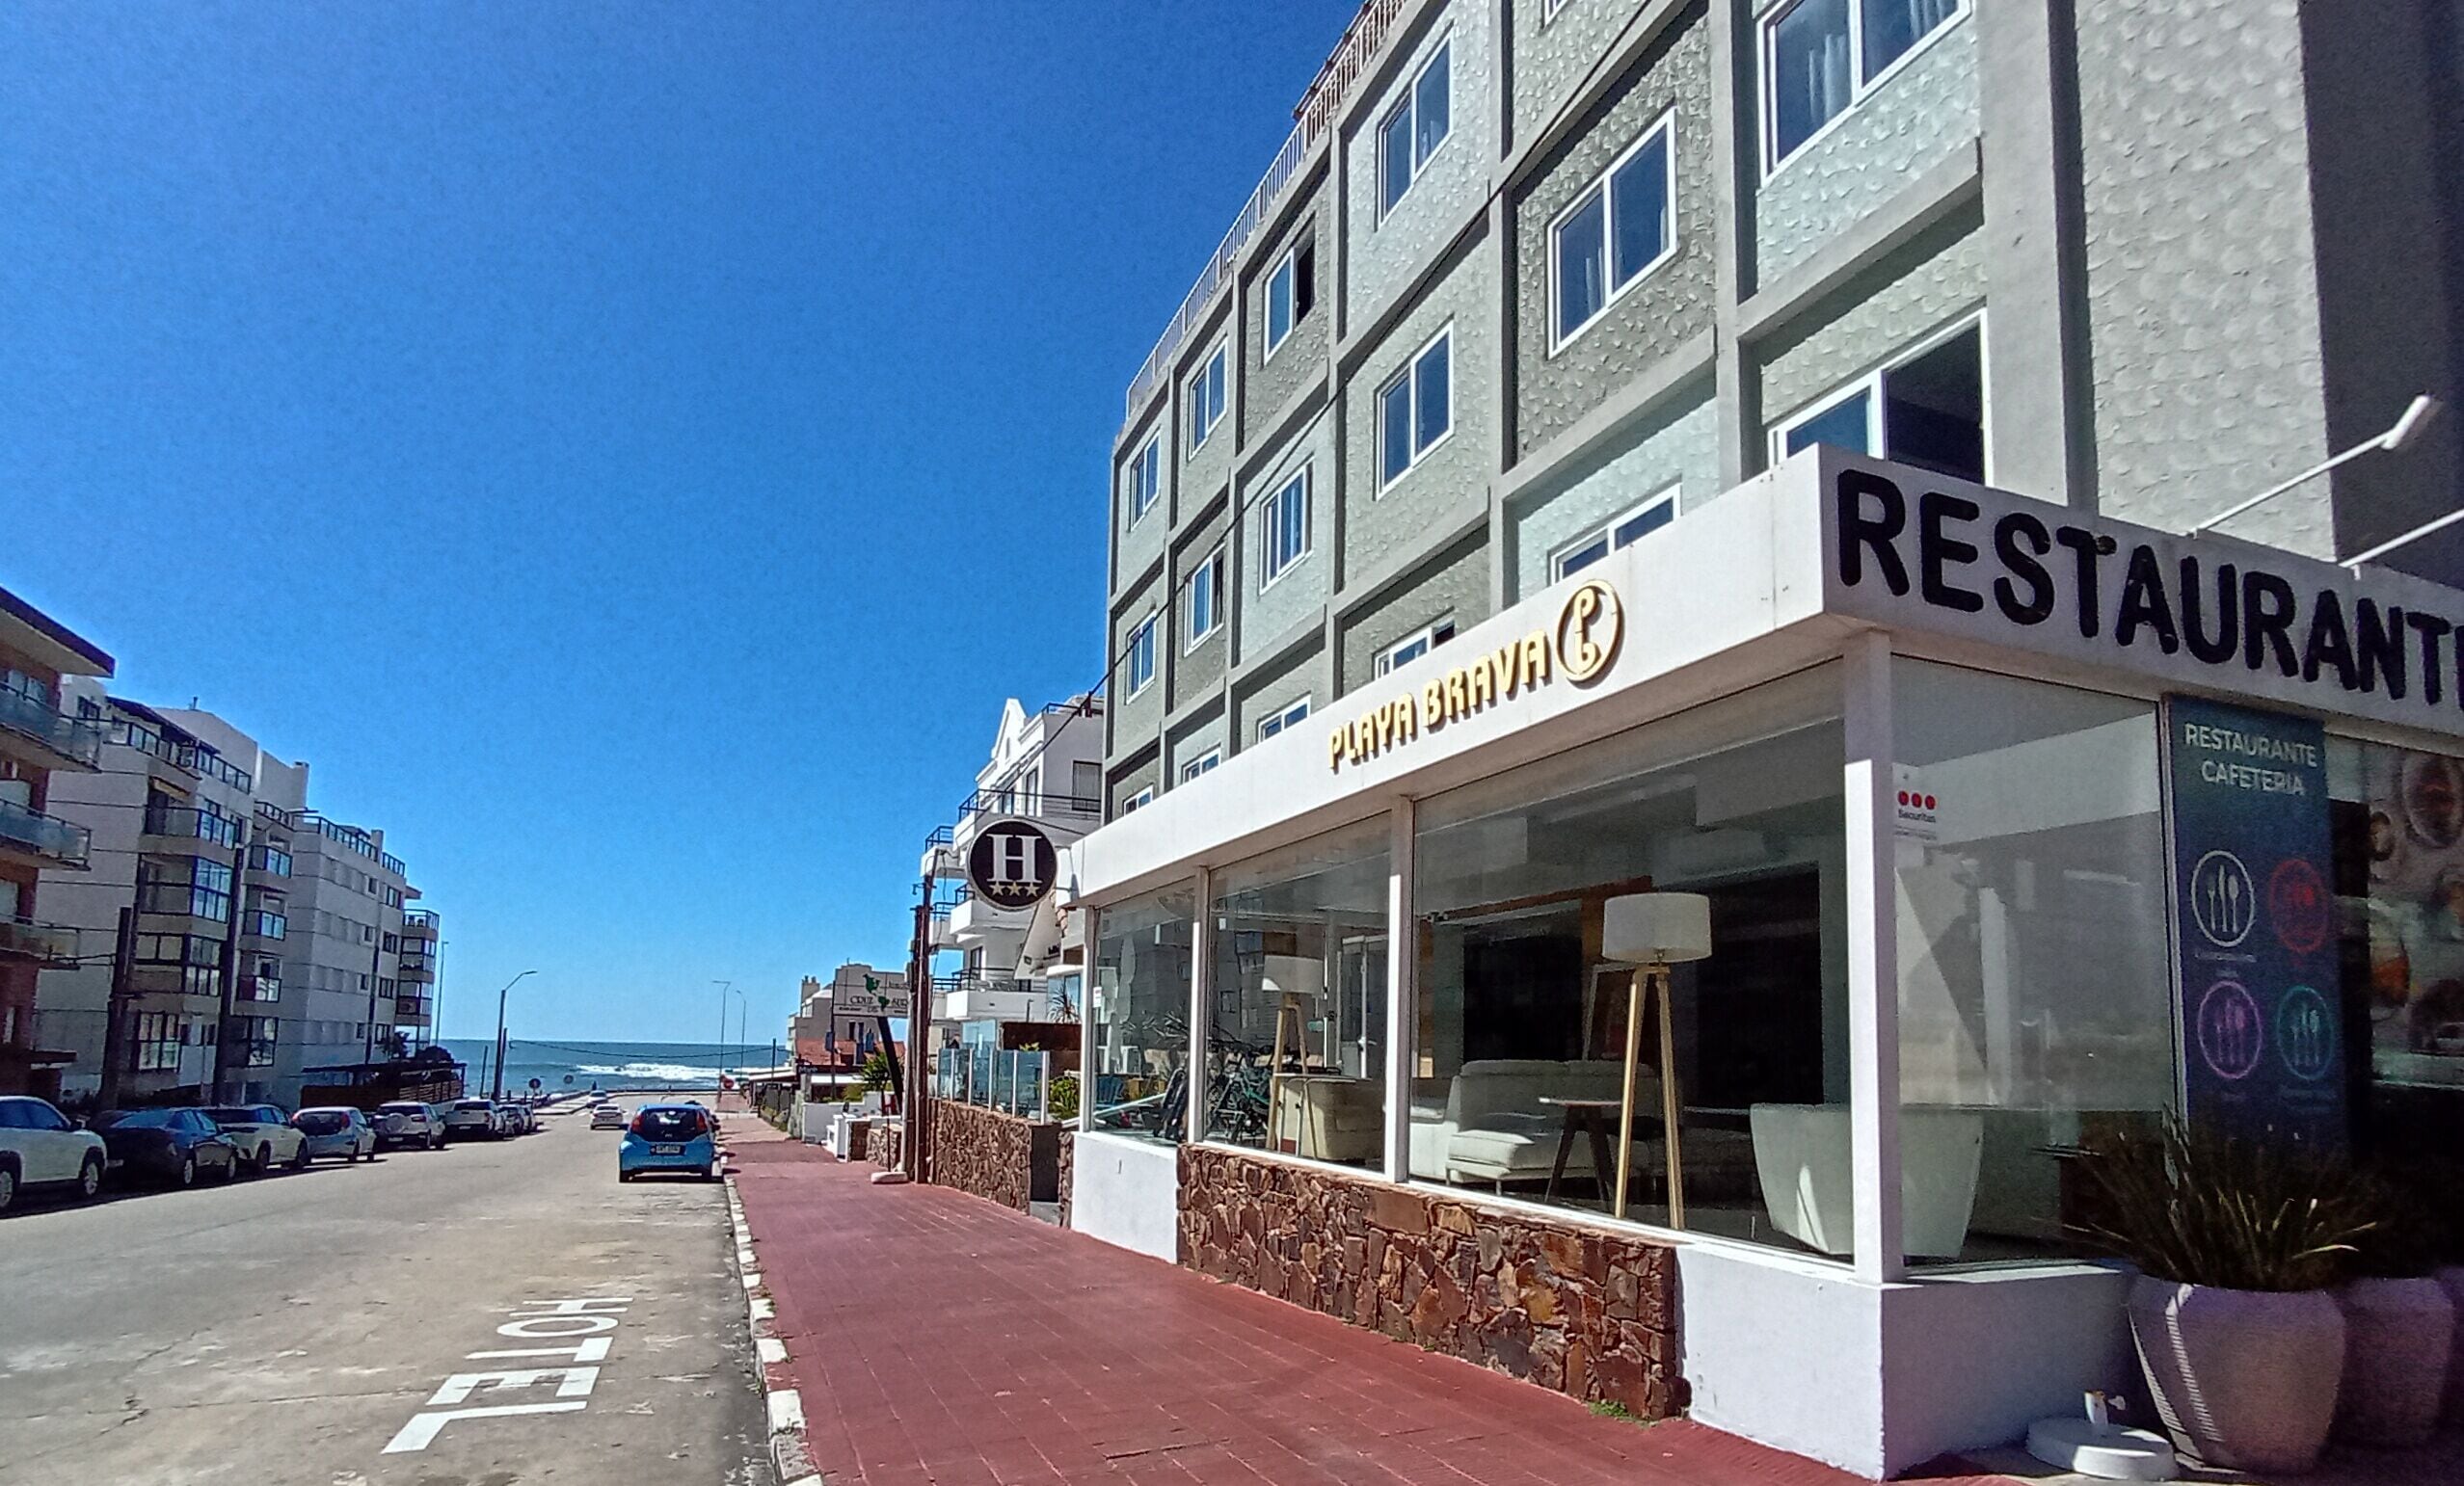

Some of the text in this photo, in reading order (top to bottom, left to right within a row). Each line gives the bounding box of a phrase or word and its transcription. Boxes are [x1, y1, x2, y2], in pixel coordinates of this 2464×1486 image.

[1328, 629, 1551, 772] PLAYA BRAVA
[2184, 723, 2317, 768] RESTAURANTE
[2201, 759, 2305, 796] CAFETERIA
[985, 834, 1042, 884] H
[381, 1297, 633, 1454] HOTEL
